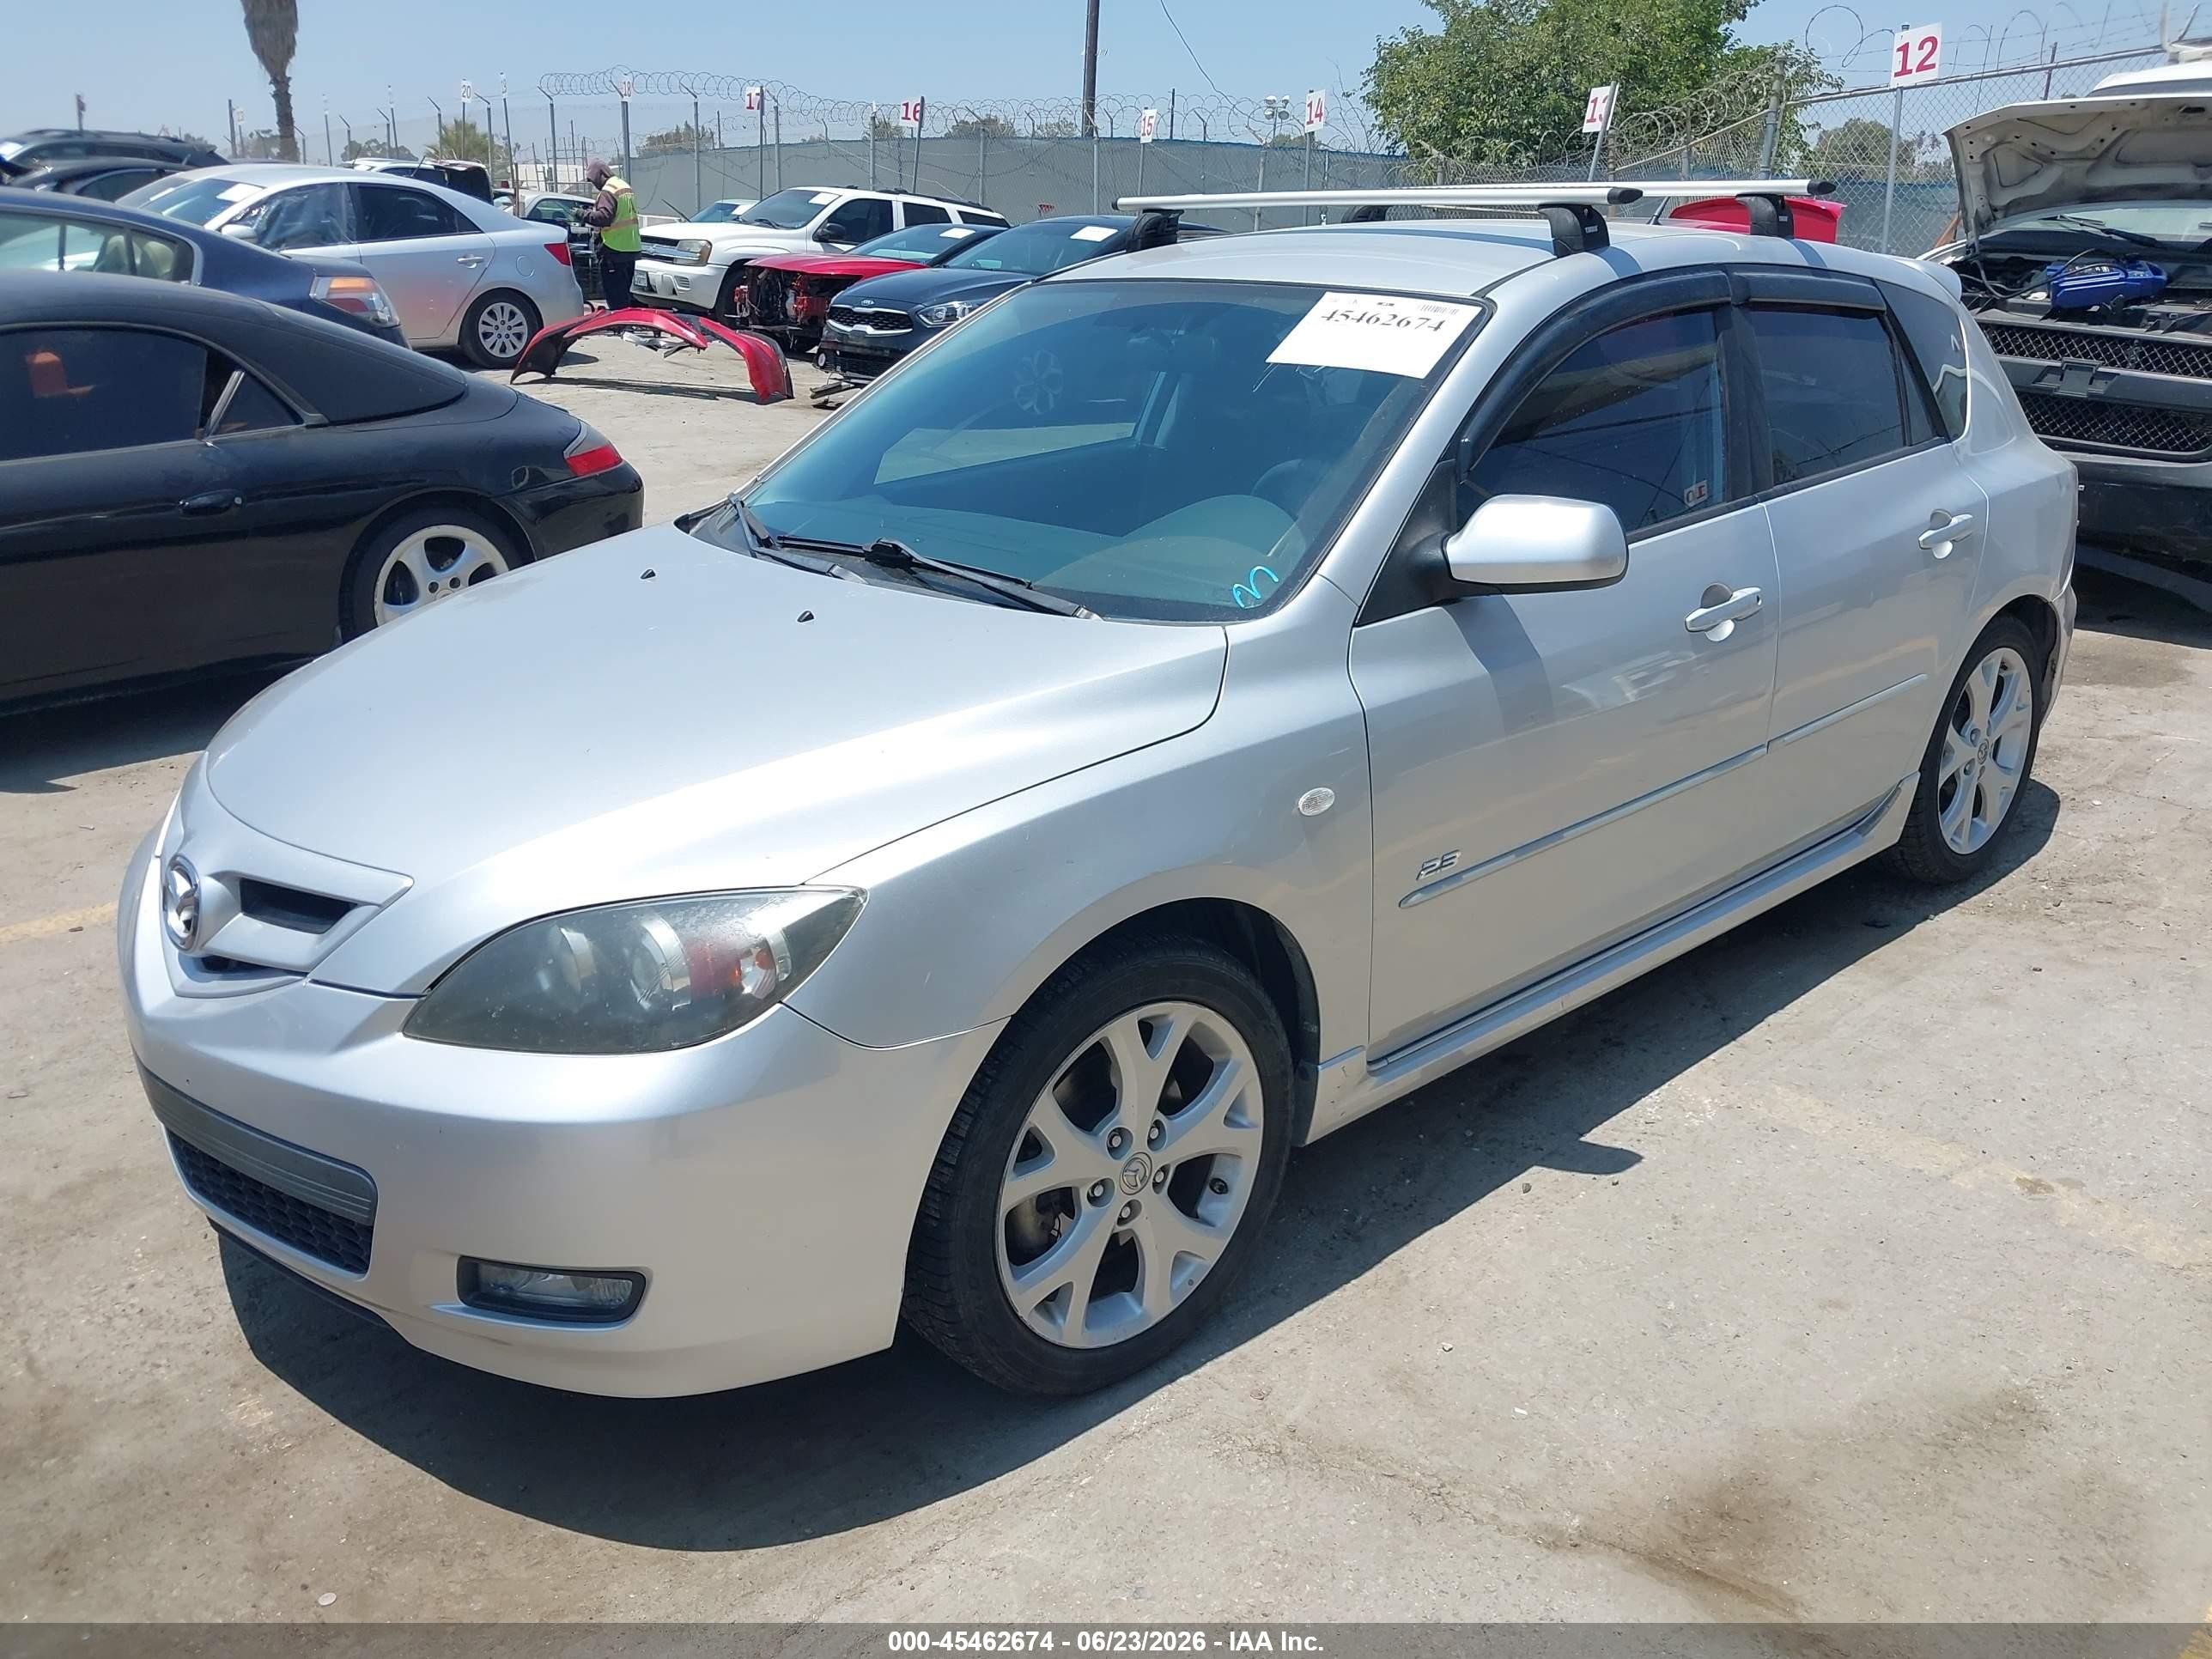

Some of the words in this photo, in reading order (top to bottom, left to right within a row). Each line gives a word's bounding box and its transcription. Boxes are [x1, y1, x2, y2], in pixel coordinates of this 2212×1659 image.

[1893, 36, 1938, 78] 12
[462, 84, 471, 99] 20
[1306, 97, 1324, 125] 14
[1141, 115, 1155, 137] 15
[1321, 309, 1446, 333] 45462674
